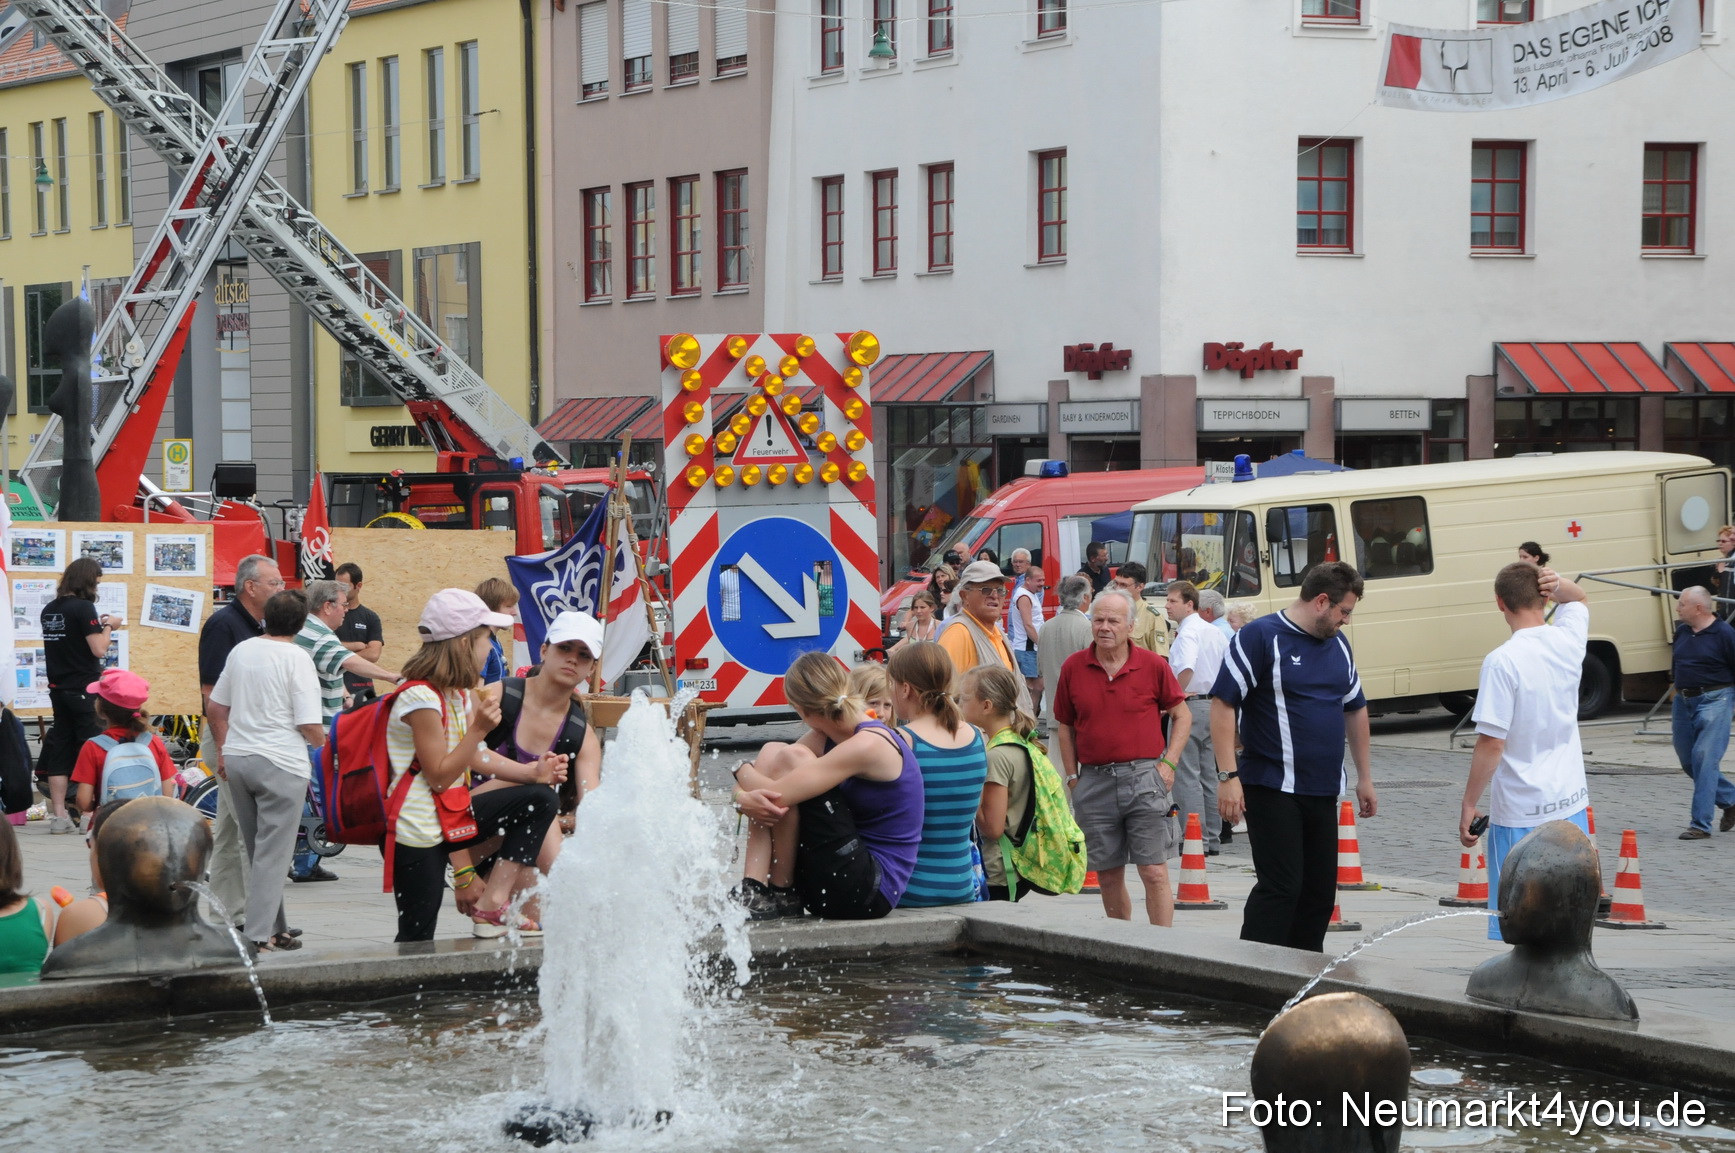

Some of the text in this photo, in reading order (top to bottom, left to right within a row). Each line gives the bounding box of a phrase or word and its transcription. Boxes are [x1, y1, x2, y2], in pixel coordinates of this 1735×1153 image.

[1513, 37, 1552, 63] DAS
[1513, 76, 1530, 94] 13.
[1536, 69, 1568, 92] April
[1586, 60, 1600, 78] 6.
[1604, 47, 1629, 71] Juli
[362, 312, 409, 359] MAGIRUS
[1064, 342, 1132, 380] Döpfer
[1203, 341, 1303, 379] Döpfer
[991, 415, 1021, 423] GARDINEN
[1062, 413, 1076, 422] BABY
[1084, 412, 1129, 421] KINDERMODEN
[1213, 410, 1281, 420] TEPPICHBODEN
[1389, 410, 1420, 419] BETTEN
[370, 425, 406, 447] GERRY
[752, 447, 789, 456] Feuerwehr
[1215, 463, 1235, 474] Kloste
[700, 680, 716, 690] 231
[1525, 787, 1589, 816] JORDA
